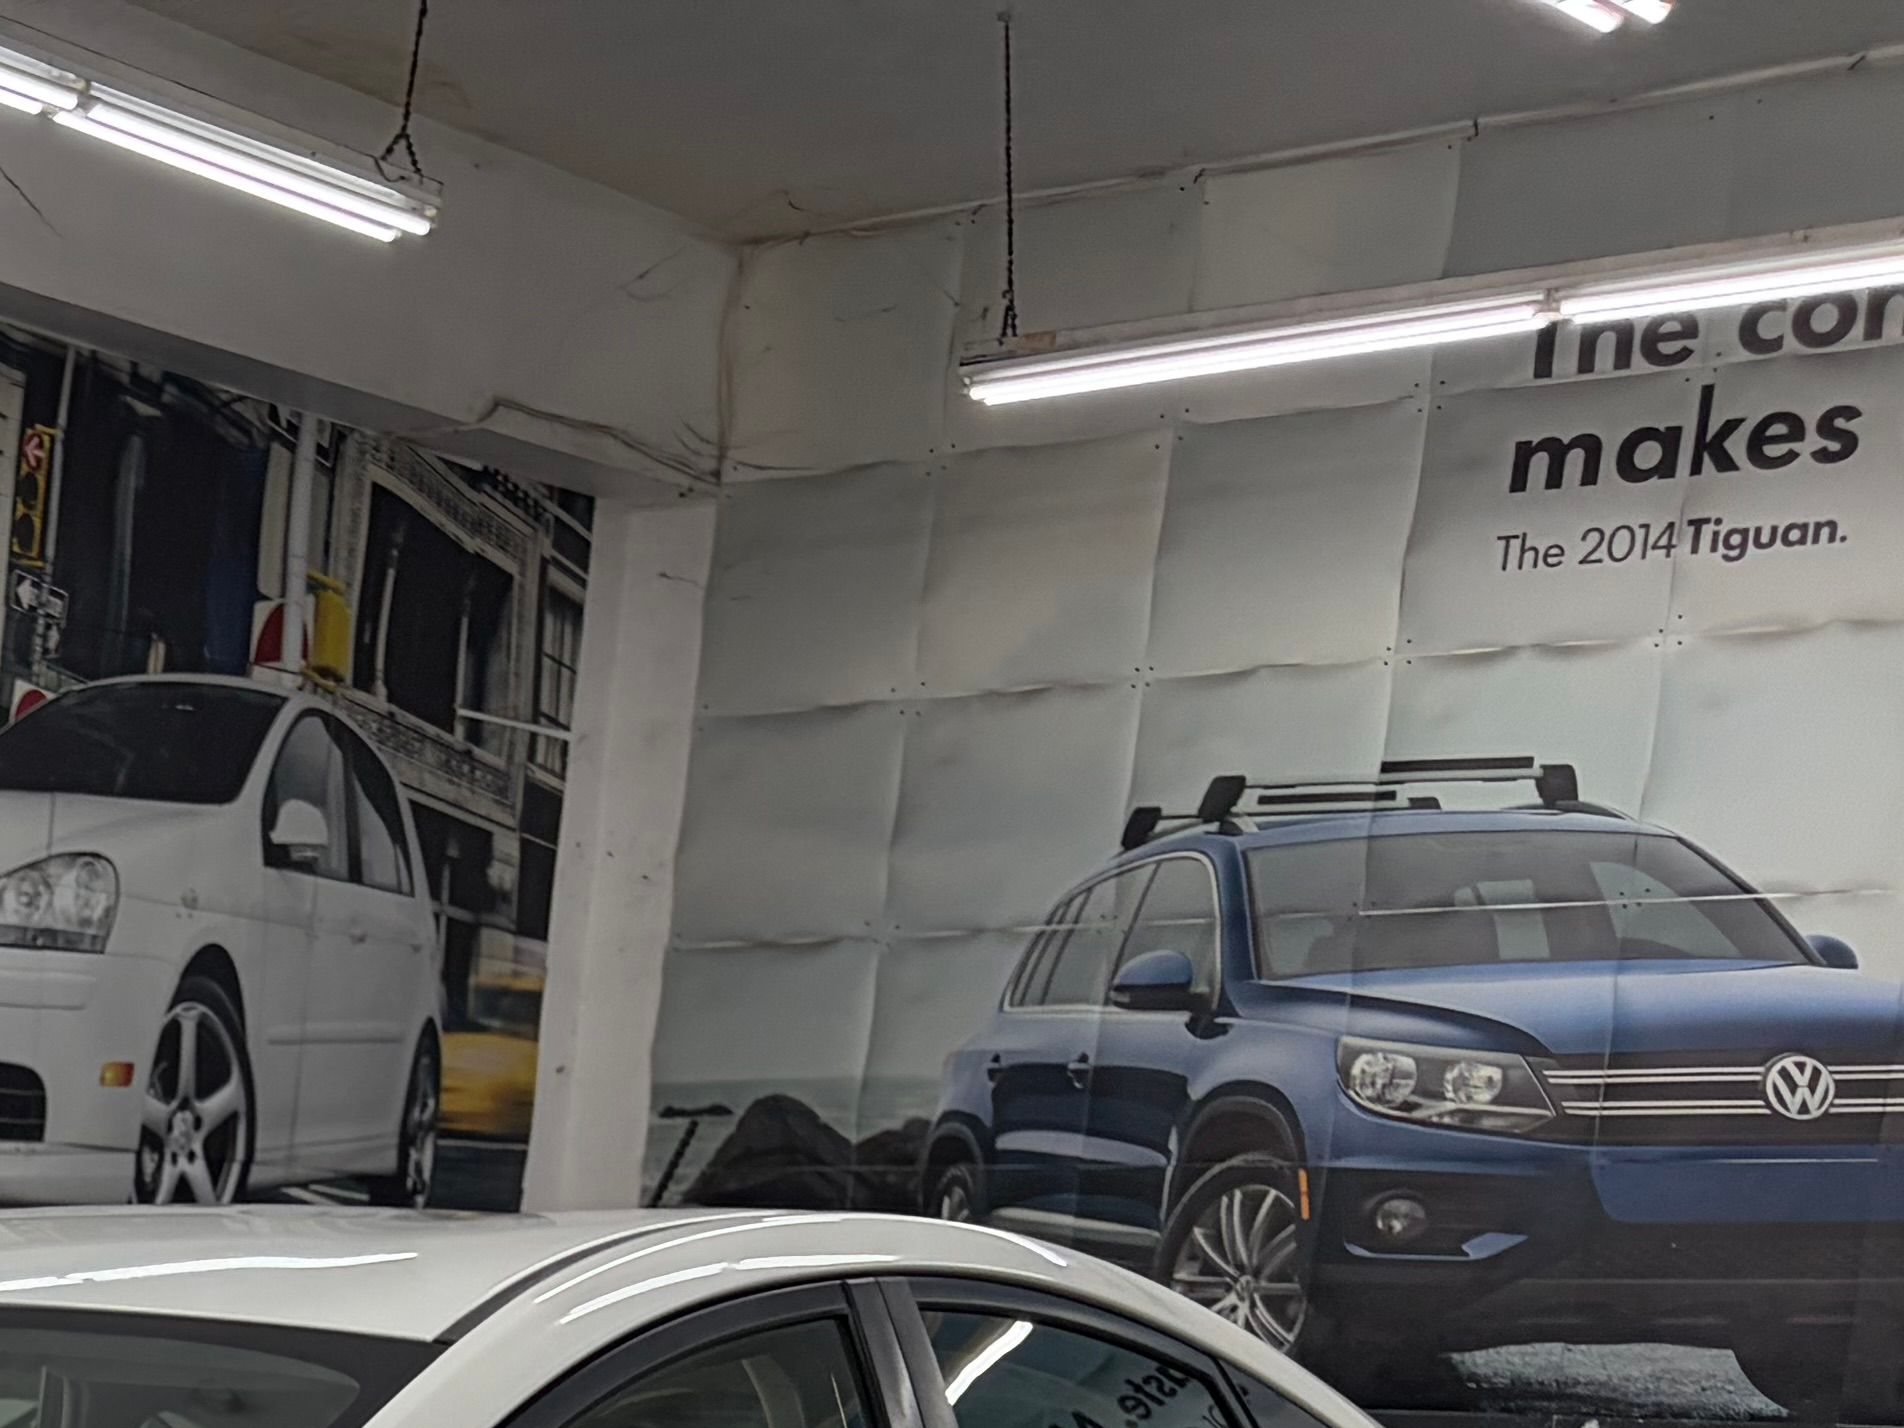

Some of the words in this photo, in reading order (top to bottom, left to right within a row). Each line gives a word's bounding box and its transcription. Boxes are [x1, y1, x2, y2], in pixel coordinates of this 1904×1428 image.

[1509, 384, 1863, 494] makes
[1497, 532, 1566, 572] The
[1578, 521, 1677, 565] 2014
[1686, 517, 1848, 562] Tiguan.
